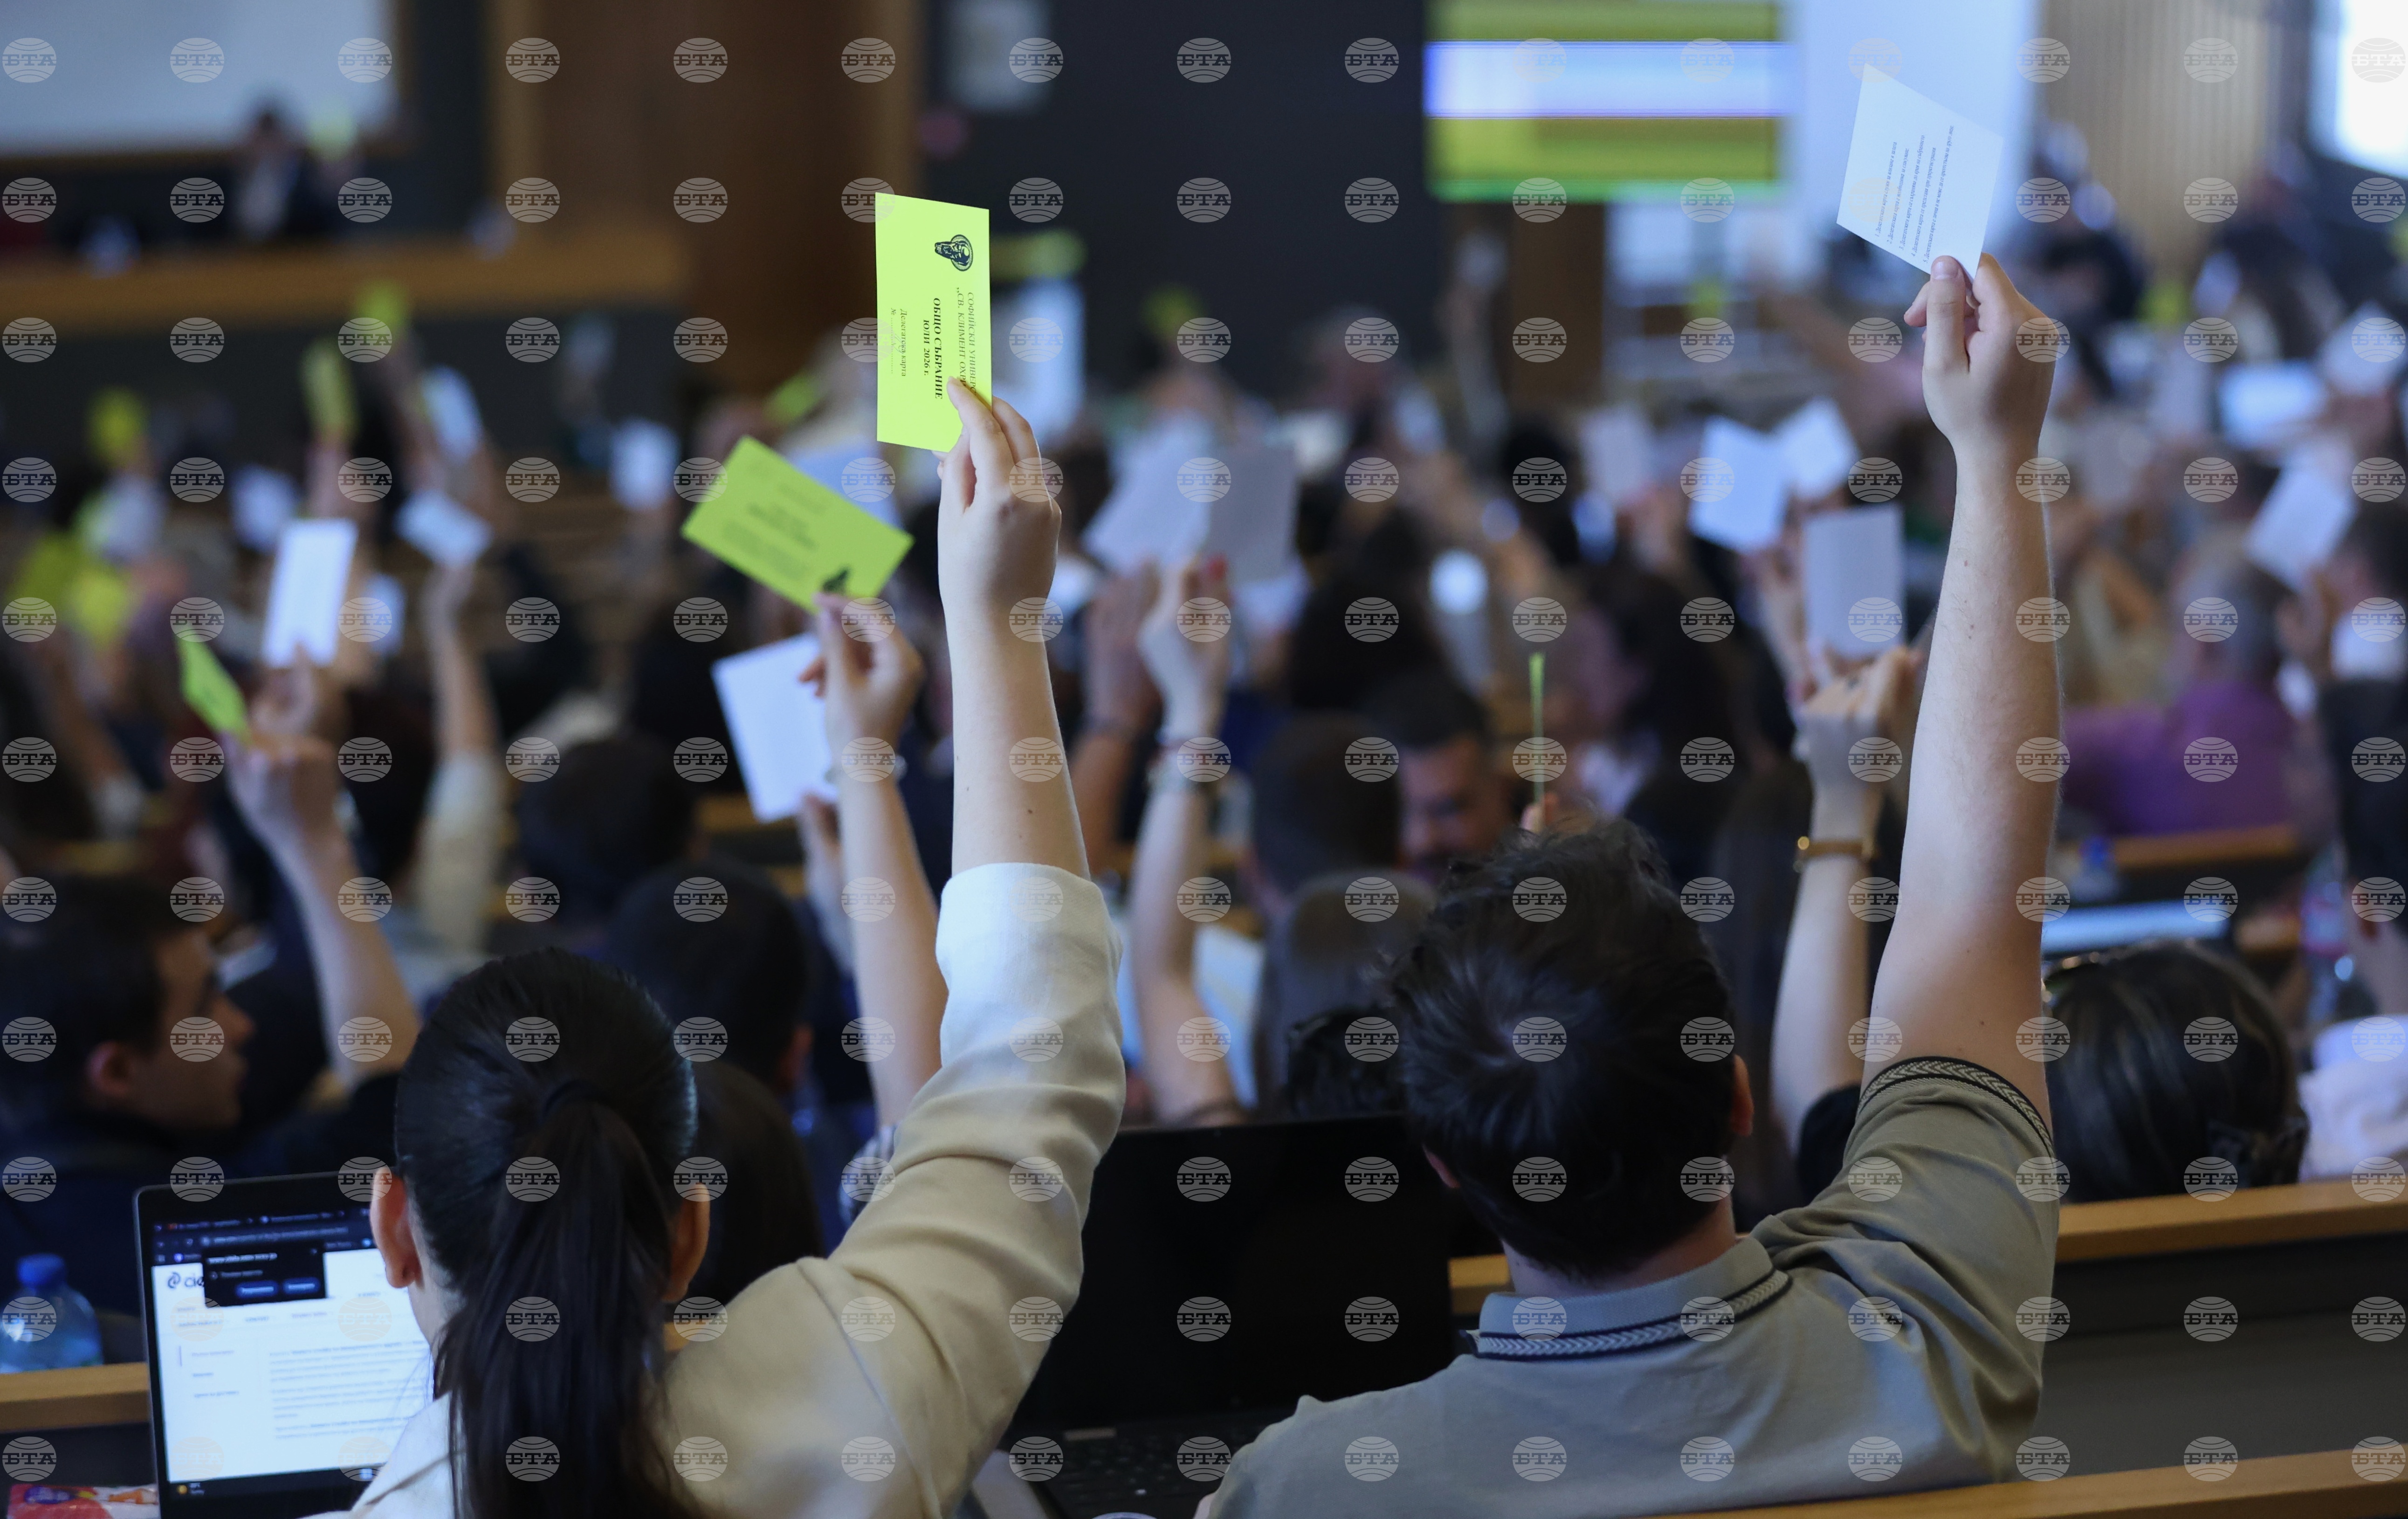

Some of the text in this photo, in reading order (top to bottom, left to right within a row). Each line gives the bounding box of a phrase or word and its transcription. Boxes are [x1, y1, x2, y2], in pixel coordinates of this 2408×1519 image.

[1875, 205, 1885, 234] Делегатската
[1887, 211, 1898, 240] Делегатската
[1895, 173, 1905, 198] необходима
[1899, 218, 1910, 246] Делегатската
[1911, 224, 1921, 253] Делегатската
[1923, 232, 1933, 259] Делегатската
[967, 292, 976, 346] СОФИЙСКИ
[933, 297, 943, 399] ОБЩО СЪБРАНИЕ
